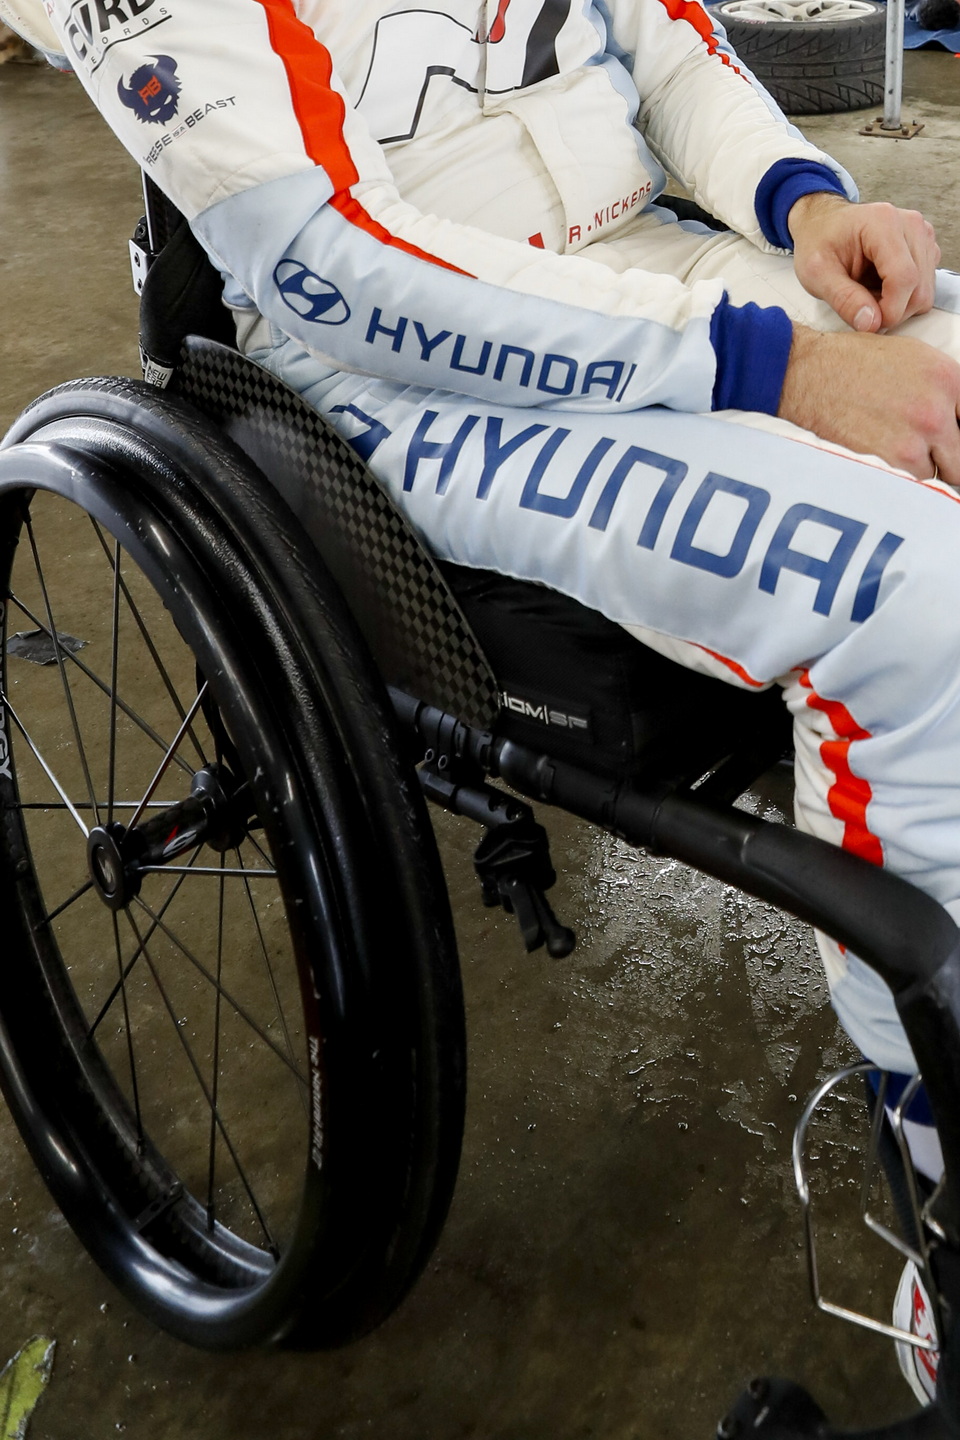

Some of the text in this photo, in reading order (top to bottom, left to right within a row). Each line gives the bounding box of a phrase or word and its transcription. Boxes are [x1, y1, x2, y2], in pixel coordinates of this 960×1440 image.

[185, 96, 236, 128] BEAST
[365, 307, 637, 402] HYUNDAI
[402, 409, 904, 623] HYUNDAI
